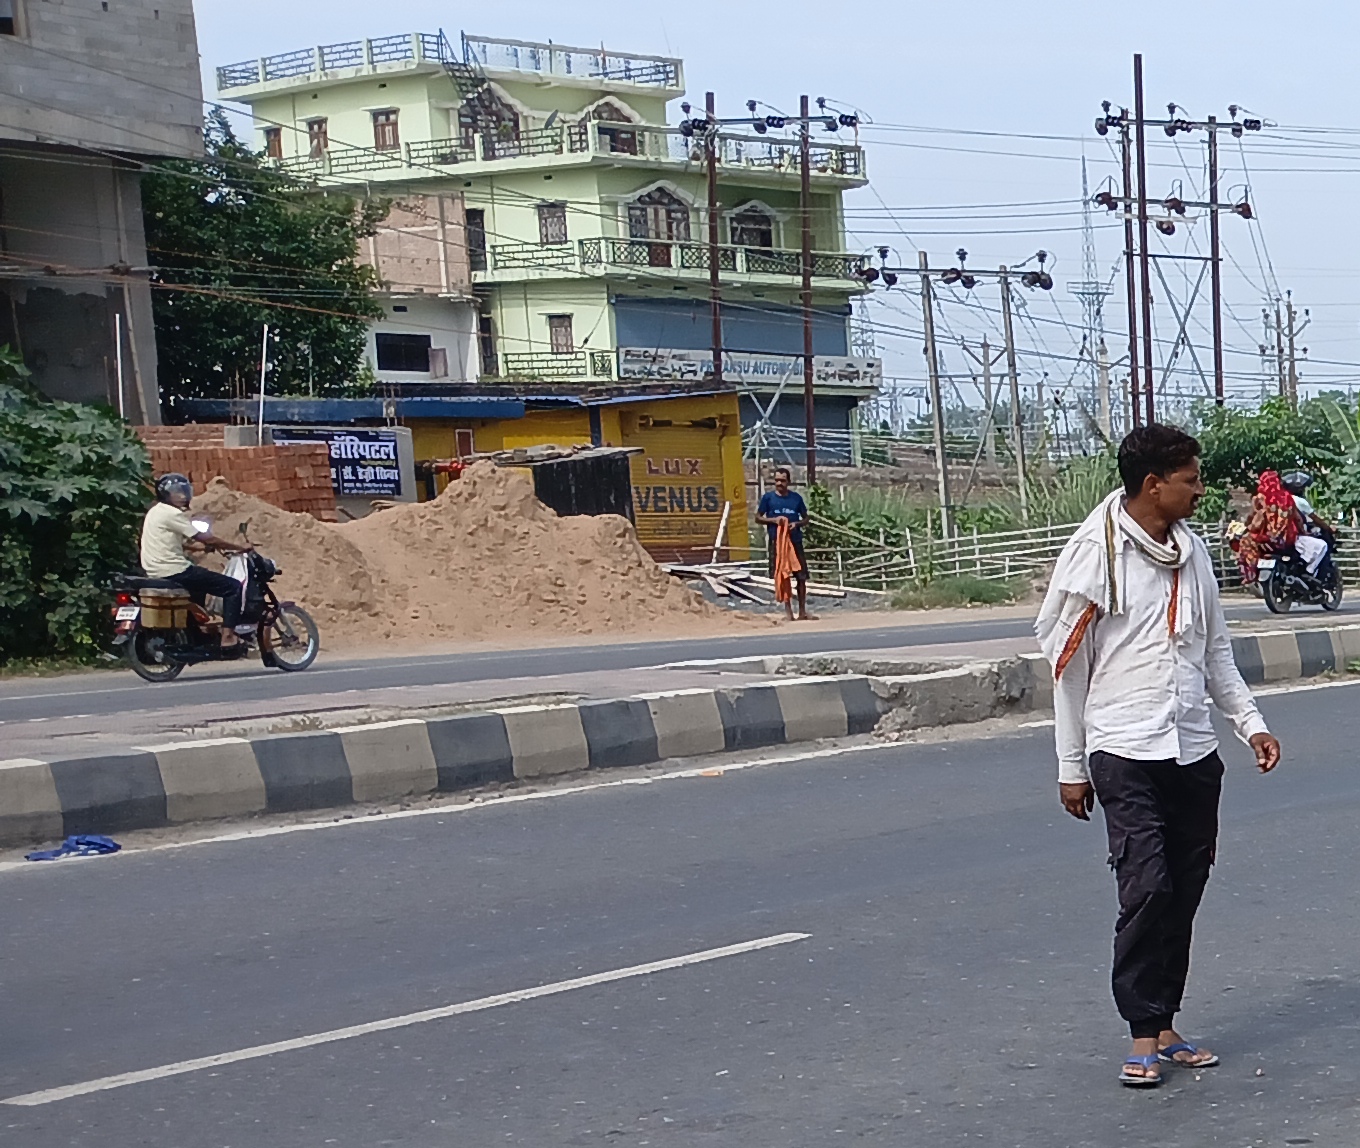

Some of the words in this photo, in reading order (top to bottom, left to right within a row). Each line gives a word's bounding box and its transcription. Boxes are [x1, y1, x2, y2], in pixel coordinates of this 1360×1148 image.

[328, 435, 396, 459] हॉस्पिटल
[646, 457, 703, 476] LUX
[633, 485, 719, 513] VENUS
